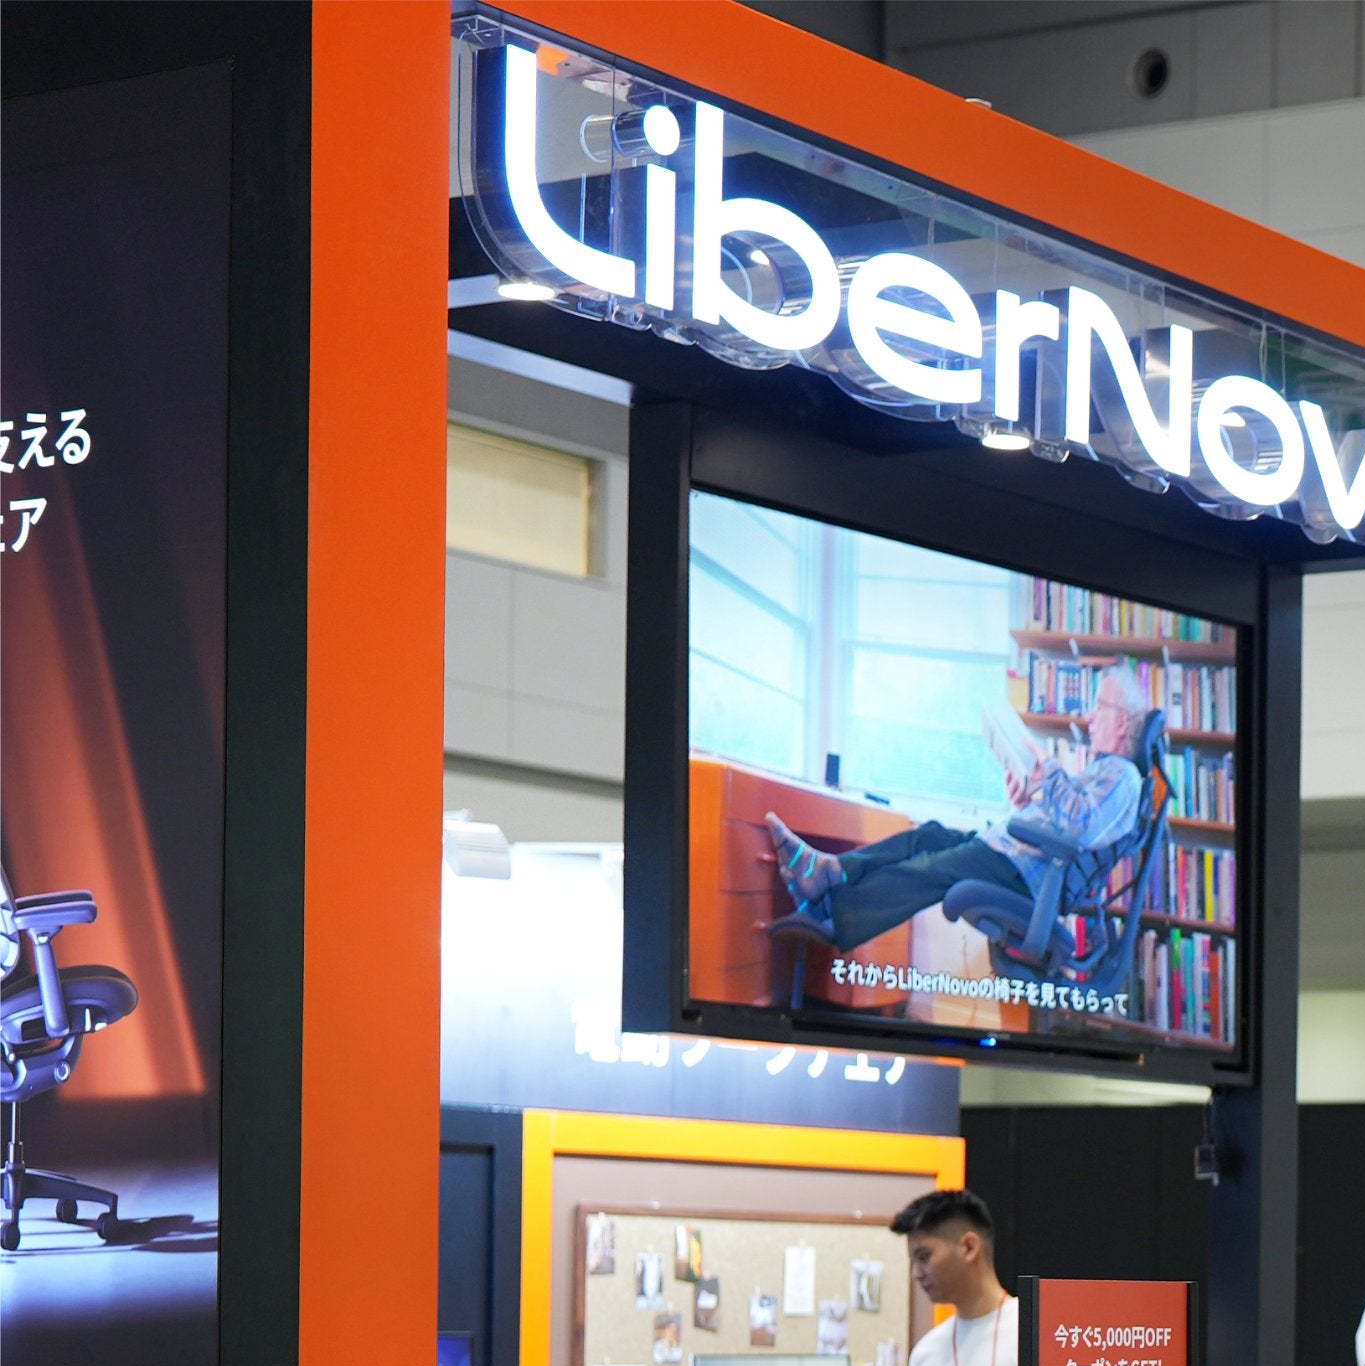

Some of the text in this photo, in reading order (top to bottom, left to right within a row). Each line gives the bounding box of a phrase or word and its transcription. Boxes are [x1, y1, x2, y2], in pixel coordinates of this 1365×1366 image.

[830, 958, 1129, 1017] それからLiberNovoの椅子を見てもらって
[1053, 1323, 1173, 1351] 今すぐ5,000円OFF
